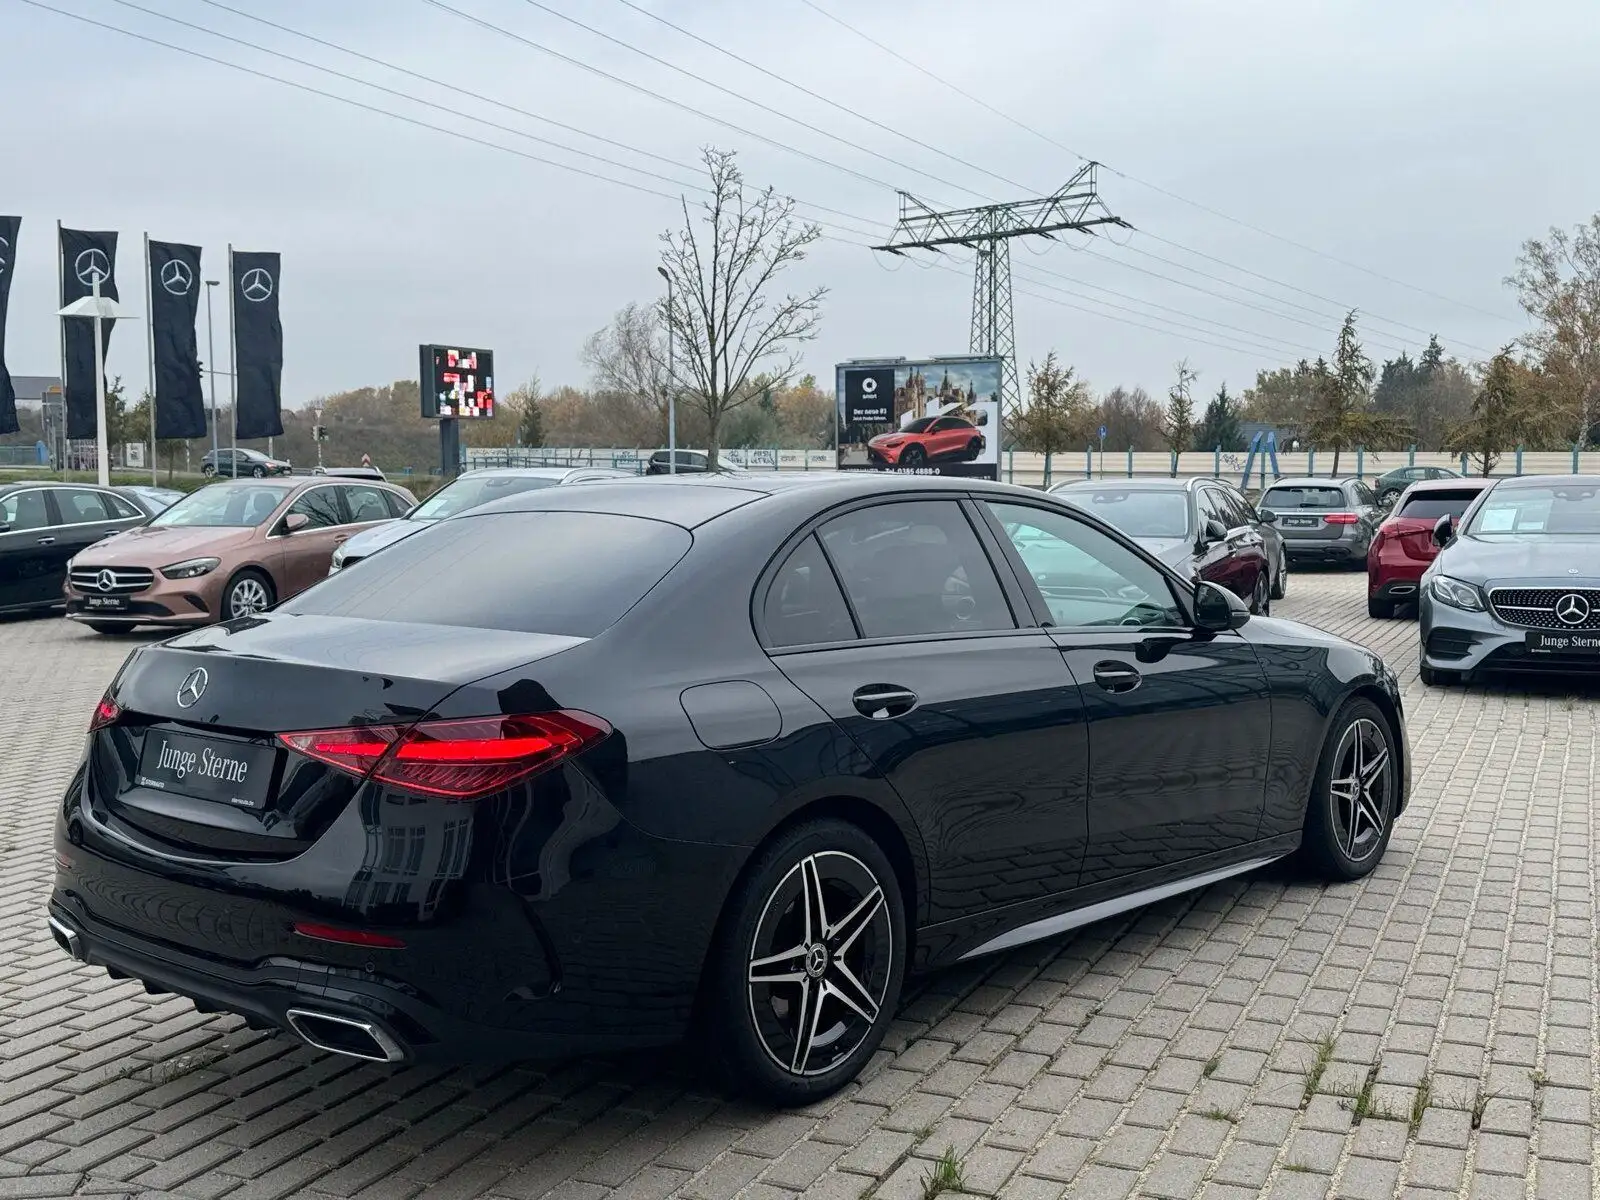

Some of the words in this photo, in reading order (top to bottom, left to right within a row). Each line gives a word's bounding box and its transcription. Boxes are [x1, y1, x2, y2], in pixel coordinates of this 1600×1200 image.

[89, 596, 102, 607] Junge
[102, 597, 120, 606] Sterne
[1540, 635, 1569, 649] Junge
[156, 740, 197, 779] Junge
[198, 747, 248, 783] Sterne
